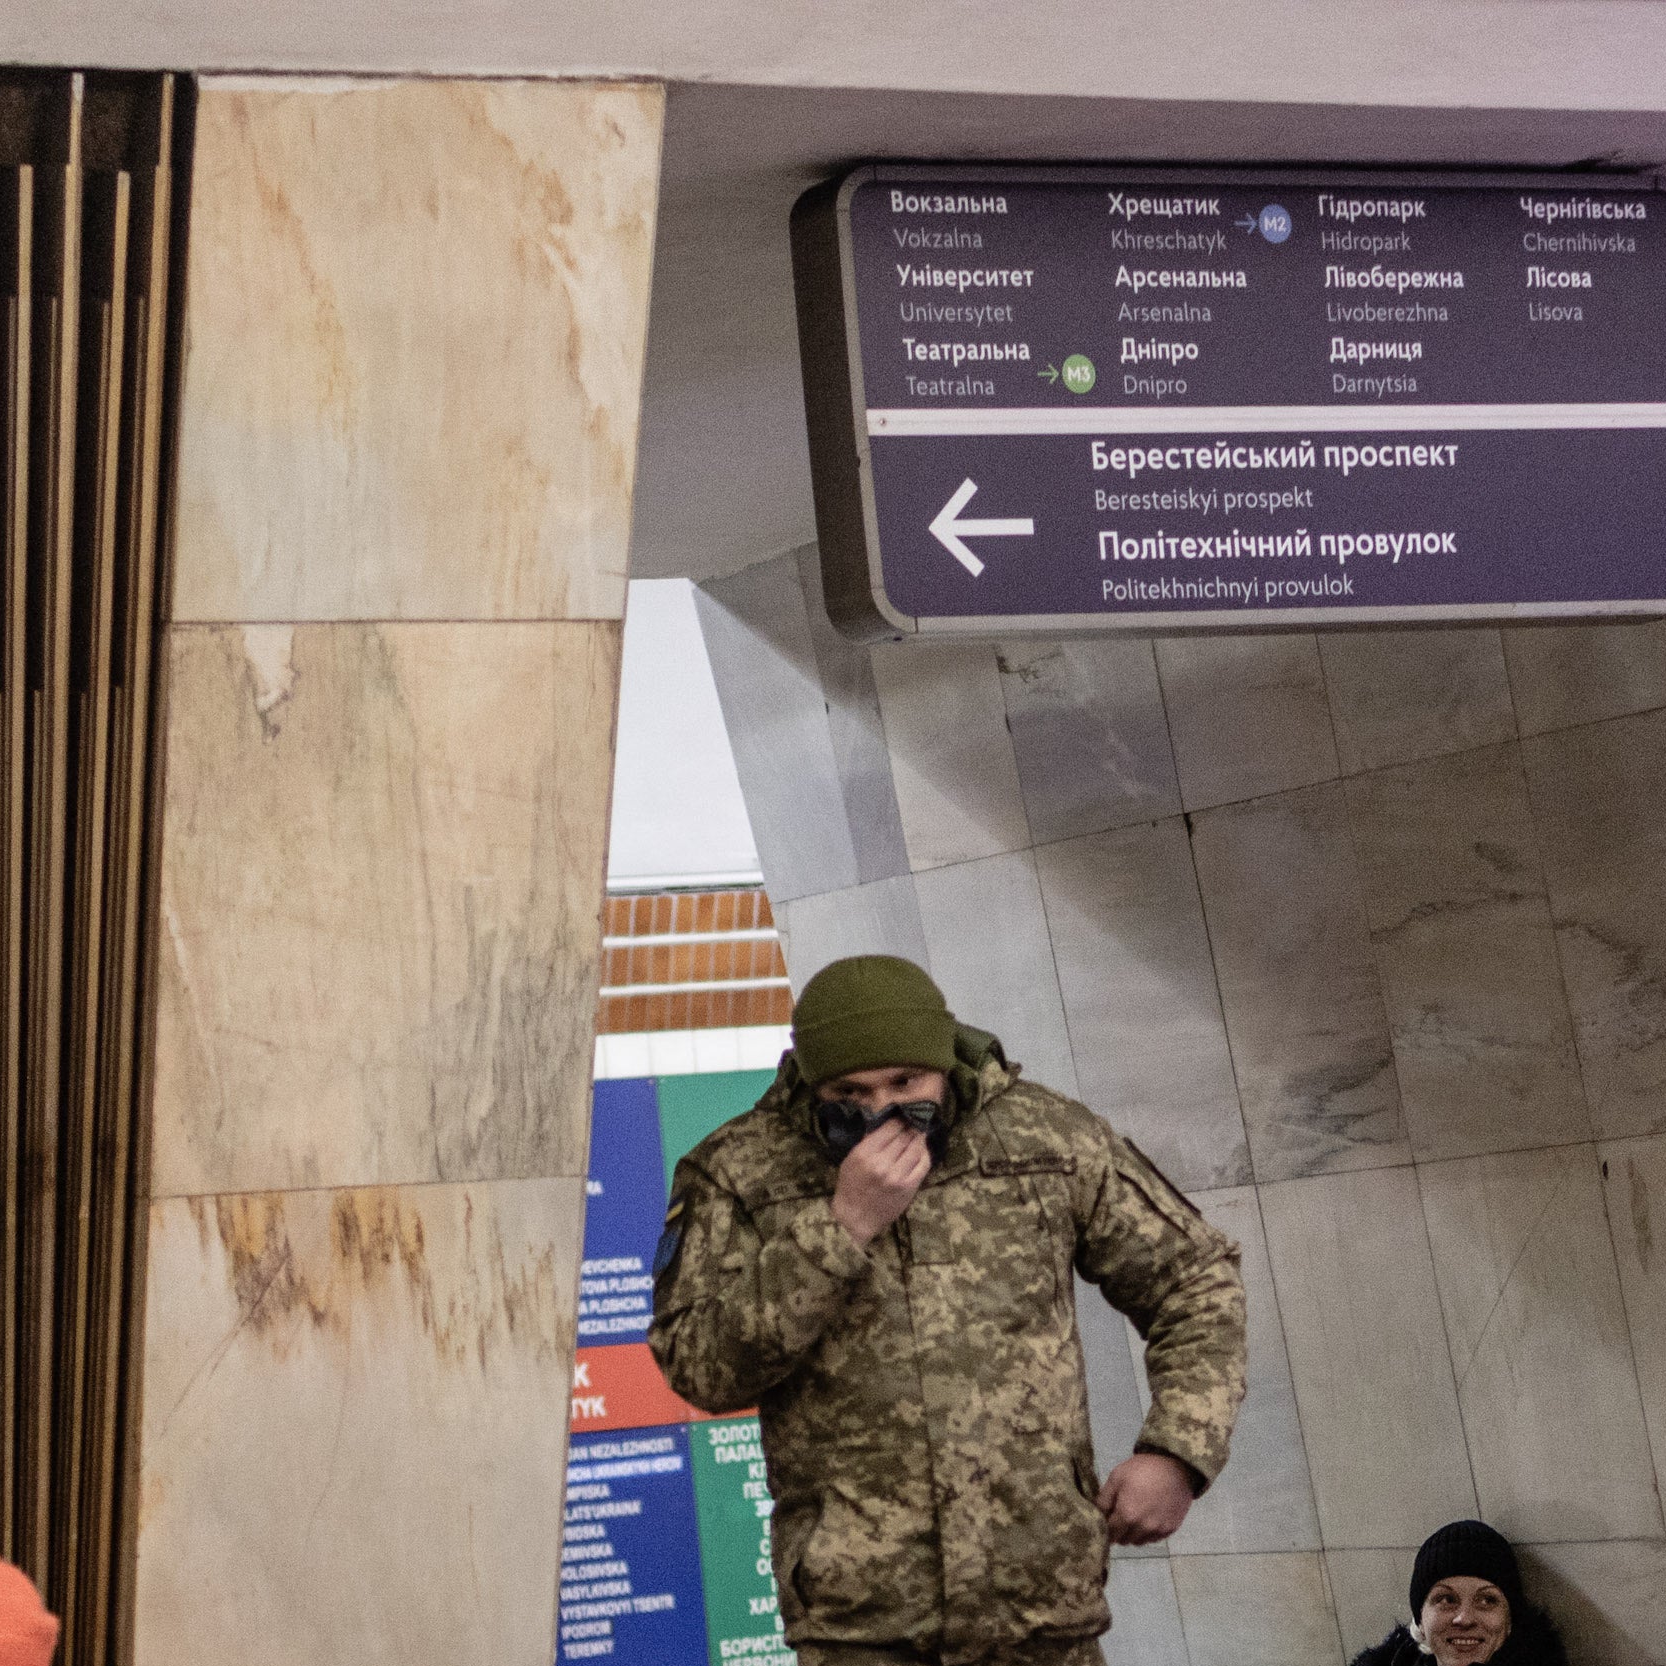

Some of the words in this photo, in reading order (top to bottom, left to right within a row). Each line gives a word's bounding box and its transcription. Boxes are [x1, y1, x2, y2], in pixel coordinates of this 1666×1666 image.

[890, 190, 1009, 214] Вокзальна
[1108, 193, 1221, 222] Хрещатик
[1317, 194, 1427, 224] Гідропарк
[1519, 197, 1647, 224] Чернігівська
[892, 227, 984, 250] Vokzalna
[1110, 229, 1227, 256] Khreschatyk
[1320, 230, 1411, 256] Hidropark
[1522, 232, 1637, 254] Chernihivska
[896, 264, 1034, 292] Університет
[1114, 264, 1248, 291] Арсенальна
[1324, 264, 1465, 294] Лівобережна
[1526, 265, 1593, 288] Лісова
[899, 302, 1014, 328] Universytet
[1117, 301, 1213, 323] Arsenalna
[1326, 302, 1449, 323] Livoberezhna
[1528, 302, 1584, 322] Lisova
[902, 337, 1031, 366] Театральна
[1119, 336, 1200, 366] Дніпро
[1329, 336, 1423, 365] Дарниця
[905, 374, 996, 397] Teatralna
[1122, 373, 1188, 399] Dnipro
[1331, 372, 1418, 398] Darnytsia
[1090, 440, 1316, 475] Берестейський
[1323, 444, 1459, 475] проспект
[1094, 487, 1219, 515] Beresteiskyi
[1223, 485, 1314, 515] prospekt
[1098, 528, 1312, 561] Політехнічний
[1319, 531, 1457, 564] провулок
[1101, 576, 1259, 604] Politekhnichnyi
[1263, 572, 1354, 603] provulok
[572, 1396, 607, 1419] TYK
[708, 1422, 761, 1445] ЗОЛОТ
[749, 1596, 777, 1615] ХАР
[719, 1634, 786, 1658] БОРИСП
